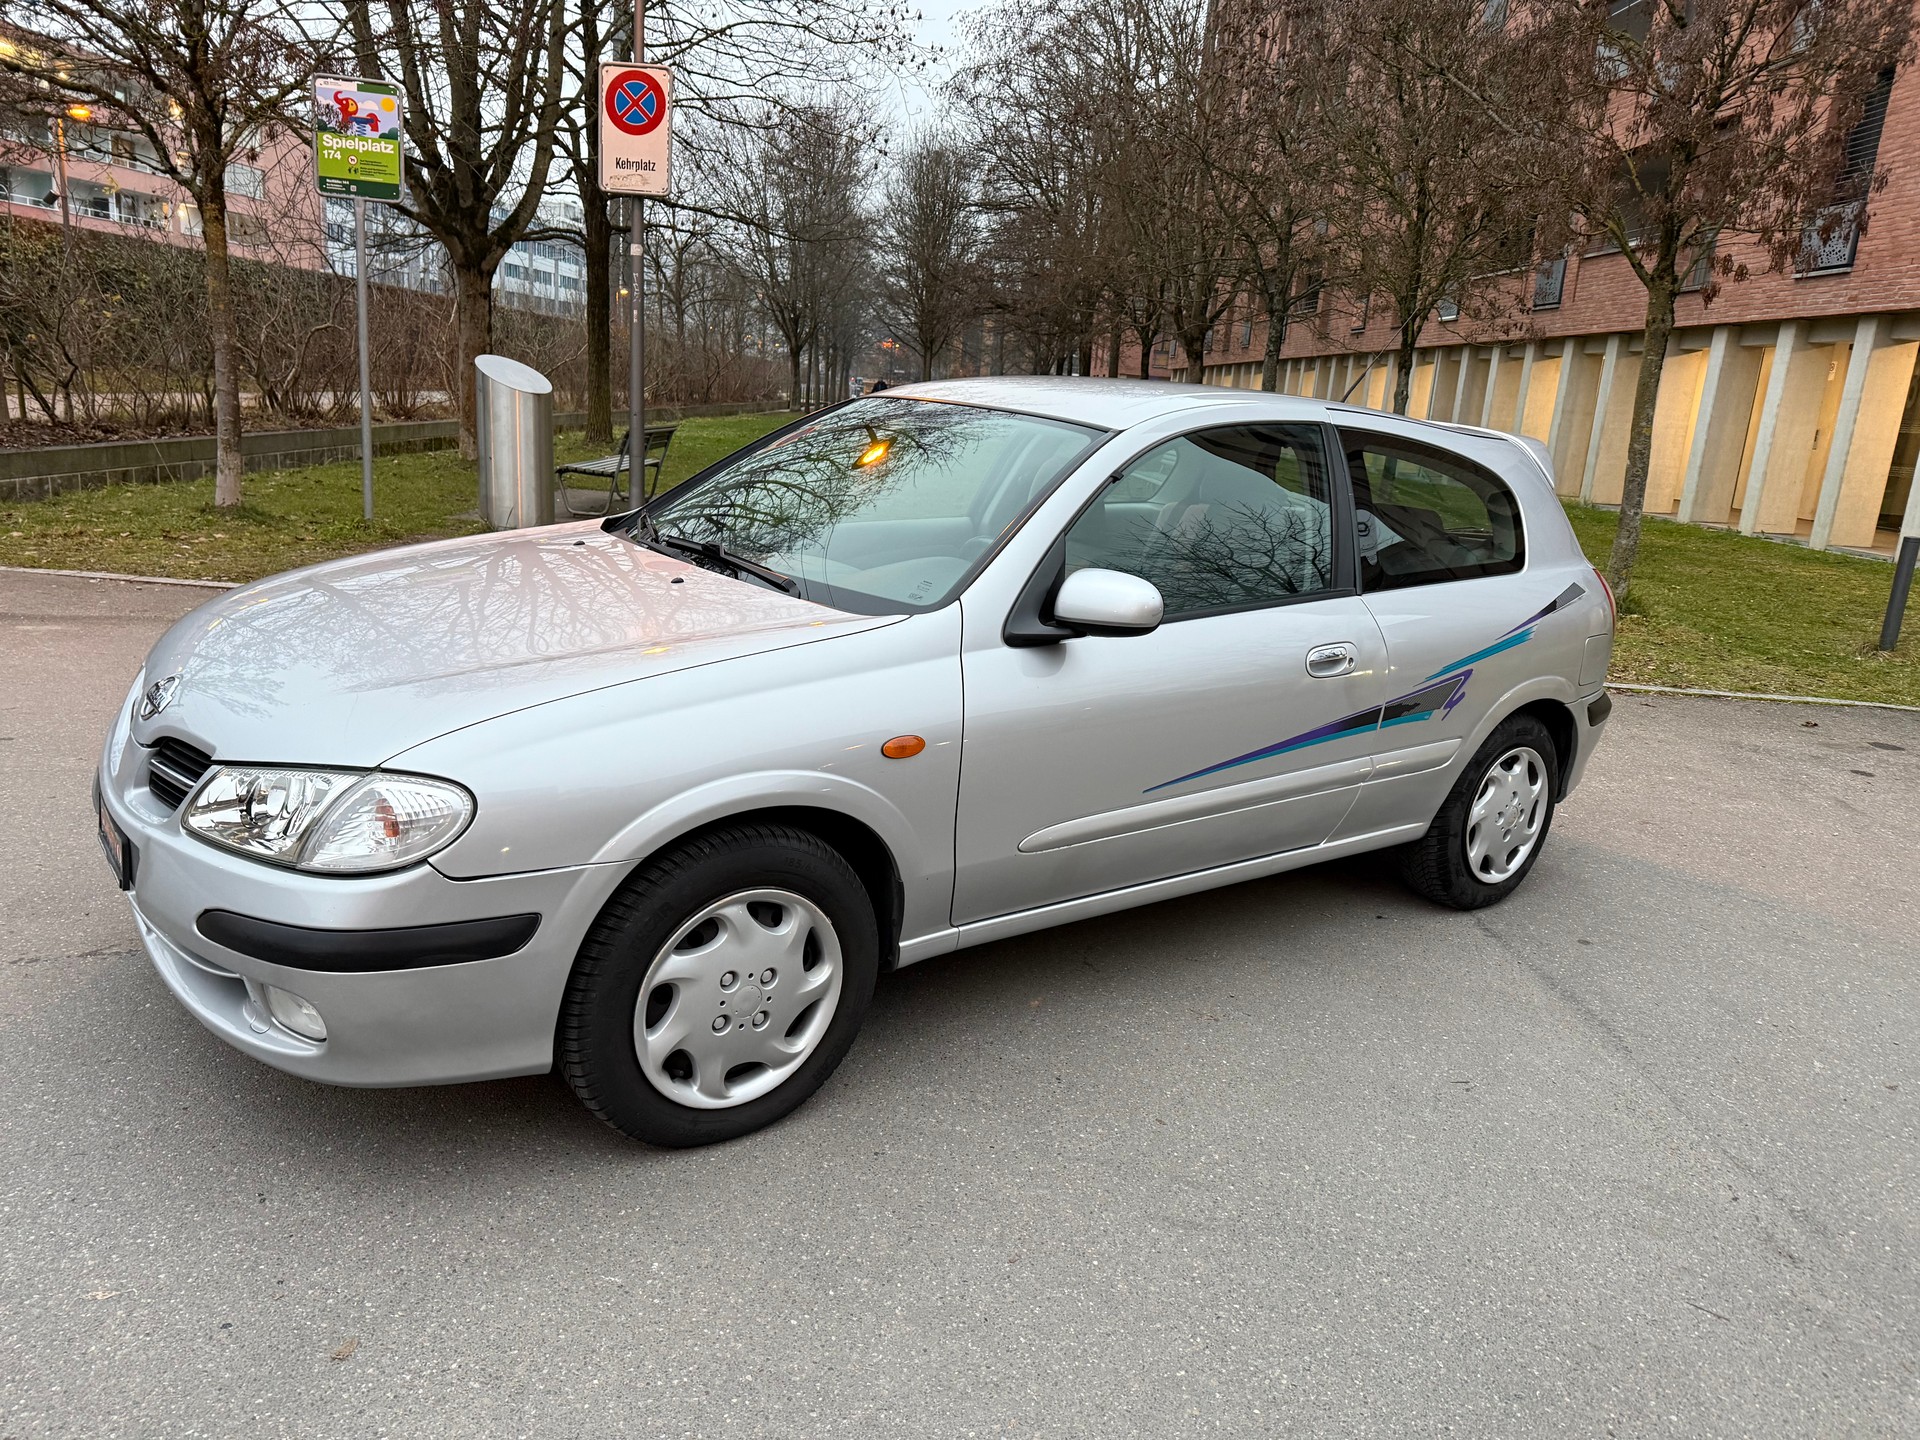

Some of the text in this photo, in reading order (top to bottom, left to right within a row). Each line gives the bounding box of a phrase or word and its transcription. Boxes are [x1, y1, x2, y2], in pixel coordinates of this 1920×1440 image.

[322, 134, 395, 154] Spielplatz
[322, 149, 342, 160] 174
[615, 157, 656, 172] Kehrplatz
